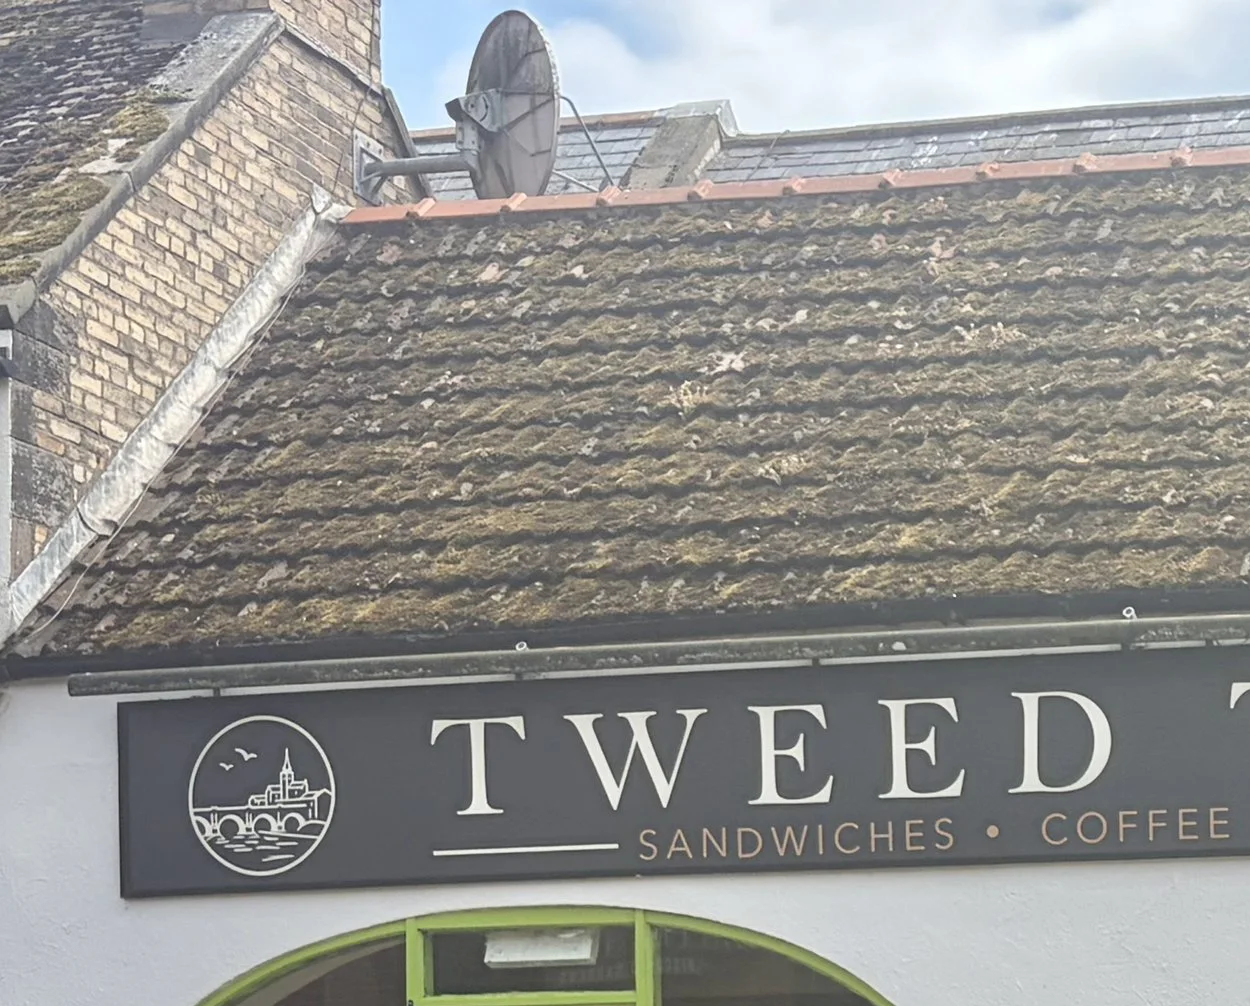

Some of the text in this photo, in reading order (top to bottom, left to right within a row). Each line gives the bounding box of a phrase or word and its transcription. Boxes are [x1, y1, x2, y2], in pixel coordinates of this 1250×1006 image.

[430, 691, 1112, 816] TWEED
[638, 816, 955, 861] SANDWICHES
[1041, 806, 1230, 846] COFFEE
